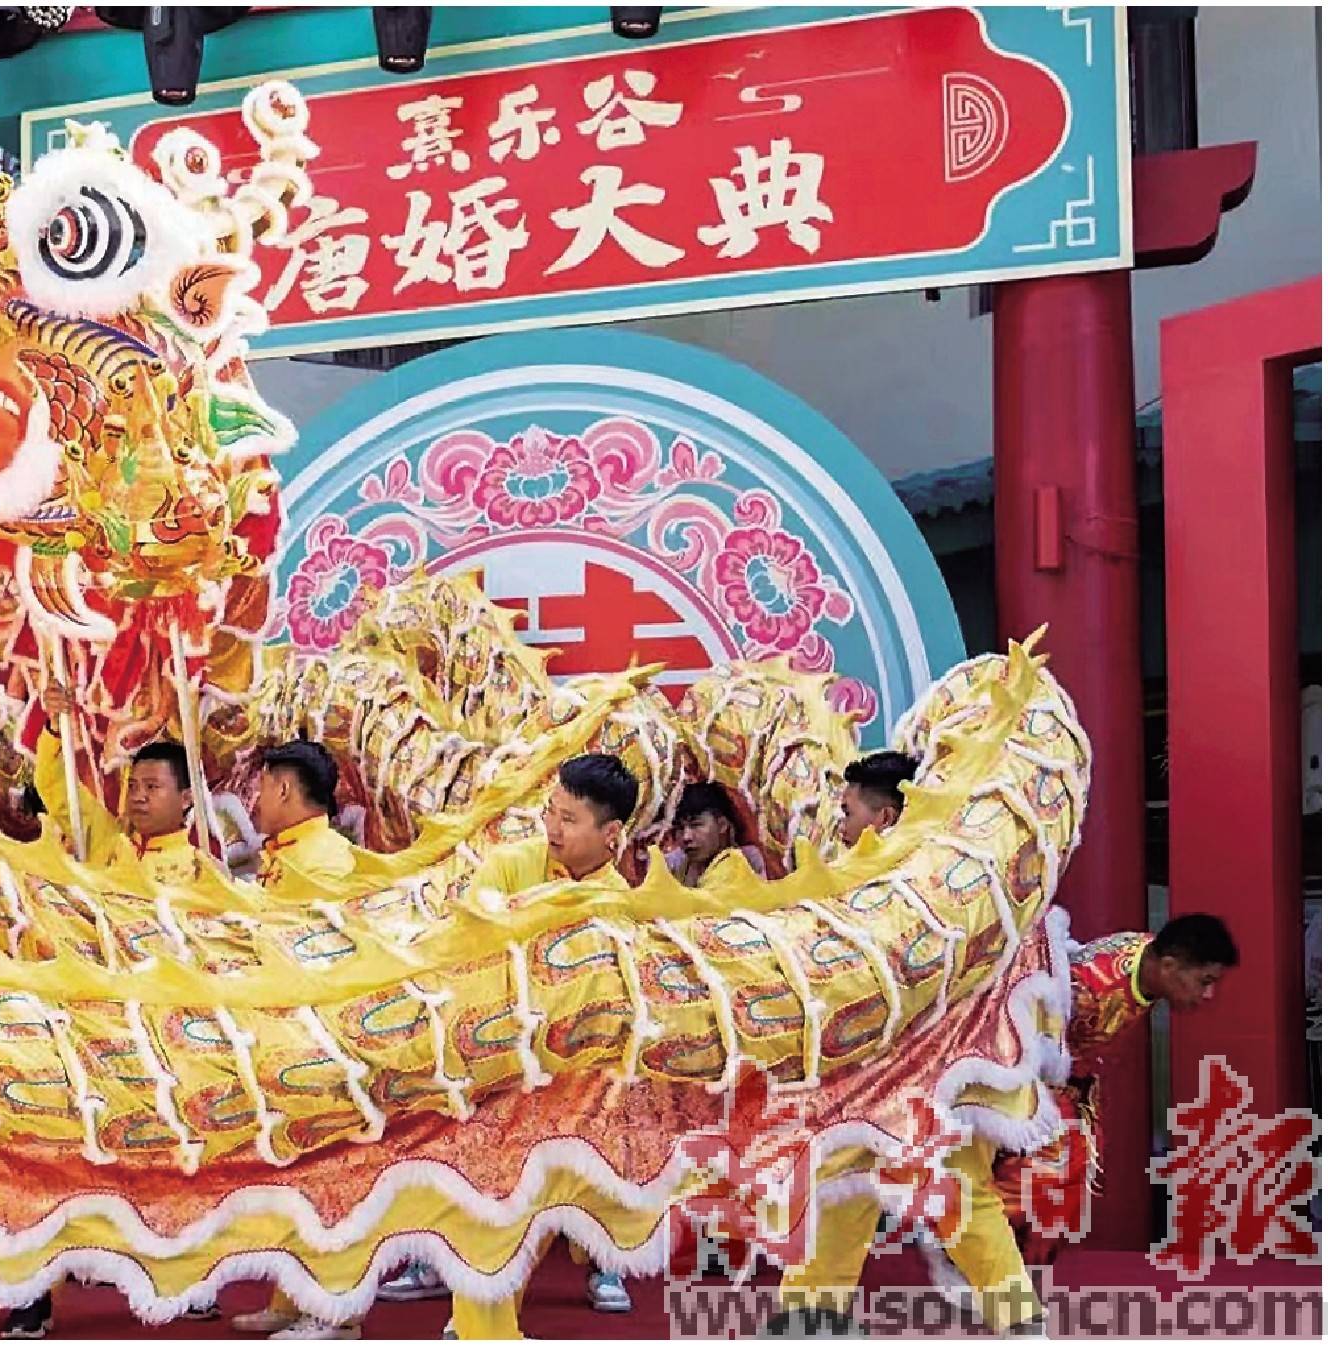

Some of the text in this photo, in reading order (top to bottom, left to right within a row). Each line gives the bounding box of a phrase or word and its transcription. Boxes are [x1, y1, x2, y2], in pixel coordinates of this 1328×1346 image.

[386, 69, 684, 180] 熹乐谷
[264, 136, 834, 314] 唐婚大典
